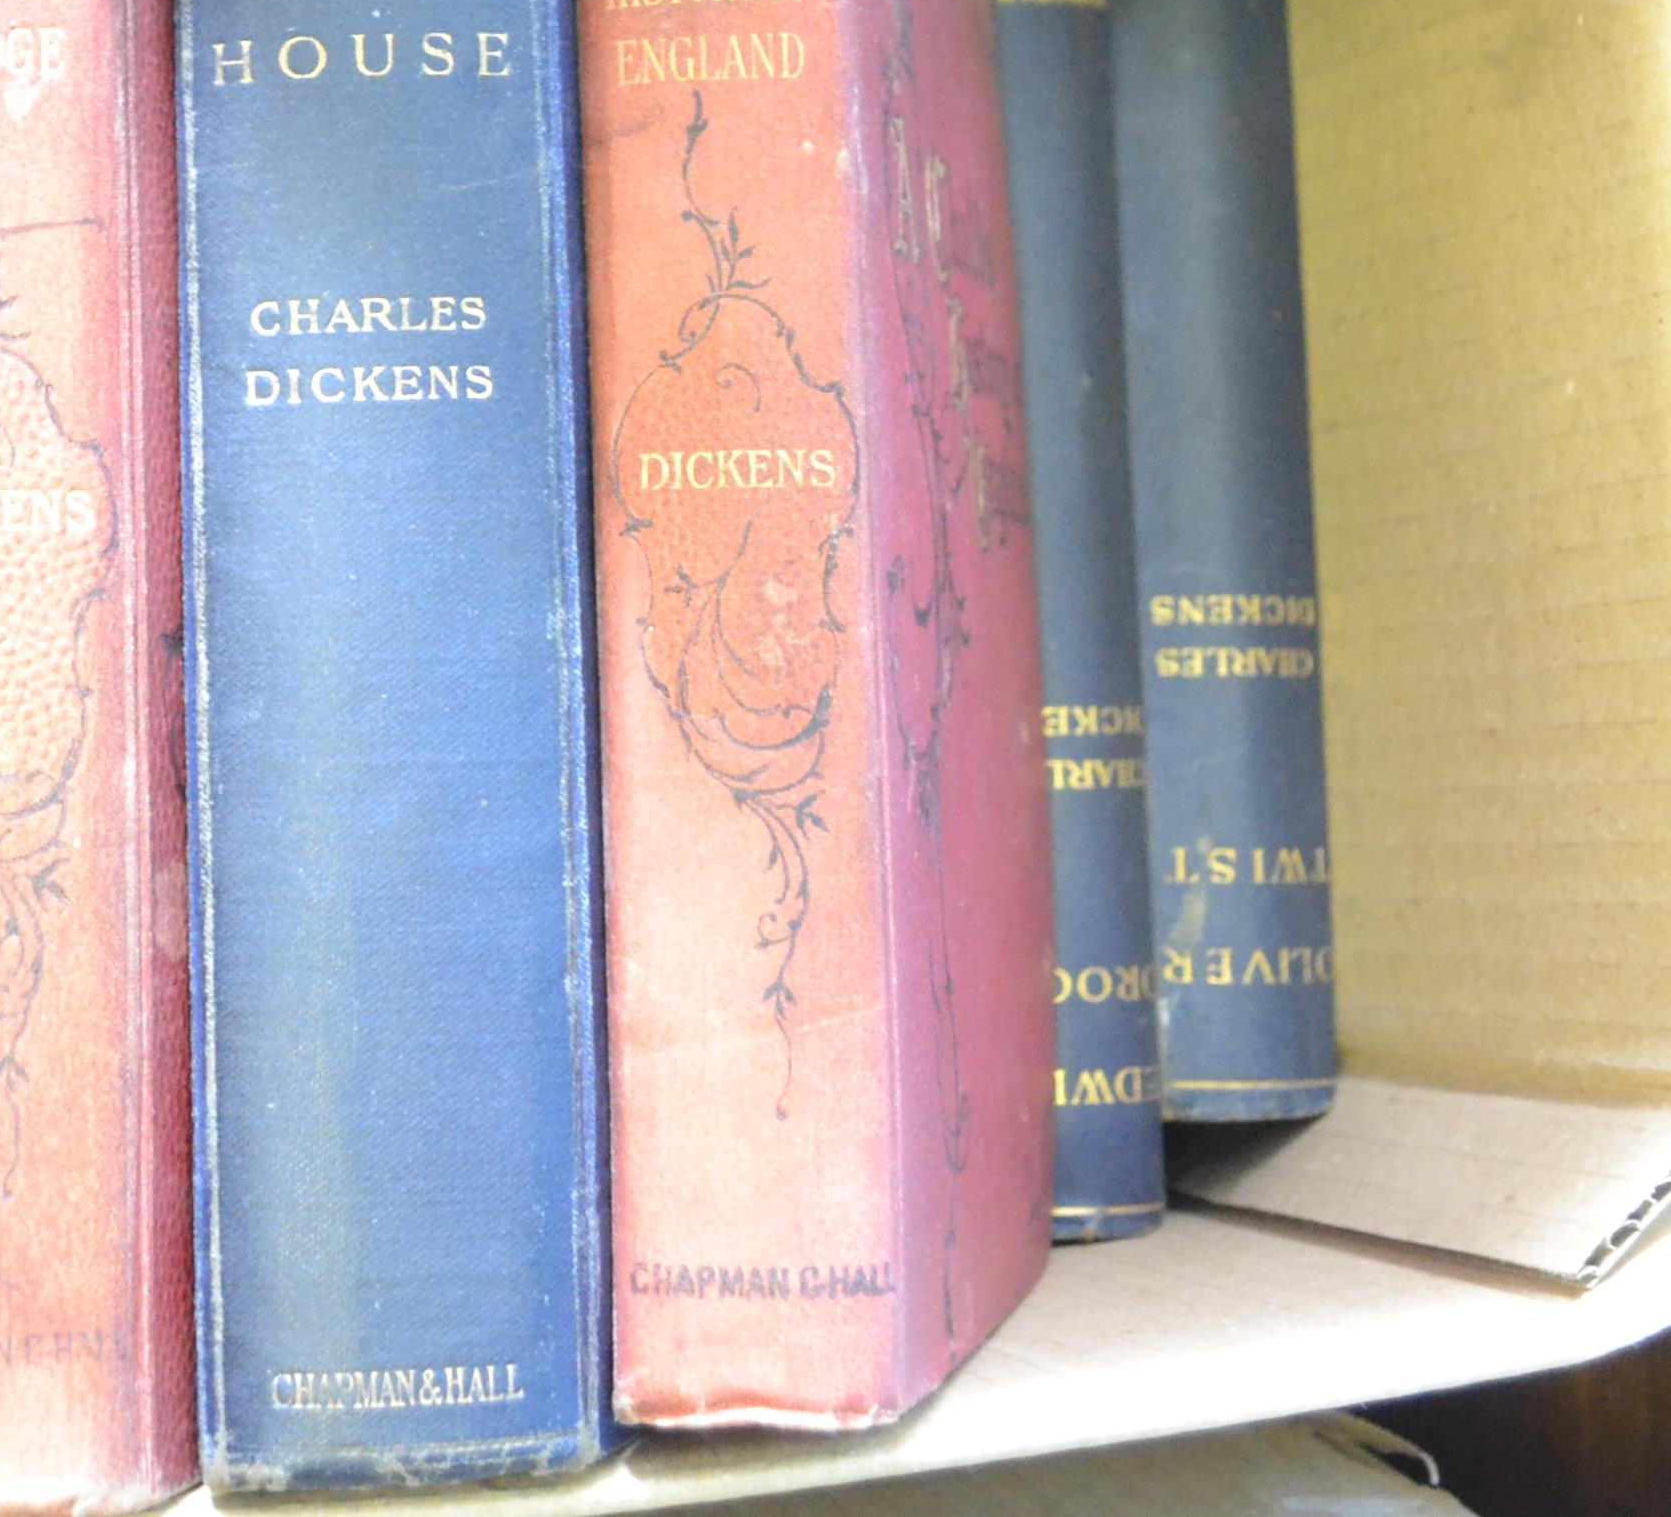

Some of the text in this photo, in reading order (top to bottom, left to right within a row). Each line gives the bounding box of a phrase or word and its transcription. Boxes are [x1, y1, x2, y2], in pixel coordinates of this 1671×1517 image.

[212, 32, 513, 86] HOUSE
[616, 32, 806, 86] ENGLAND
[250, 296, 487, 337] CHARLES
[245, 365, 494, 406] DICKENS
[638, 449, 837, 491] DICKENS
[1149, 594, 1317, 627] DICKENS
[1155, 646, 1315, 679] CHARLES
[1163, 846, 1330, 885] TWIST
[630, 1262, 790, 1300] CHAPMAN
